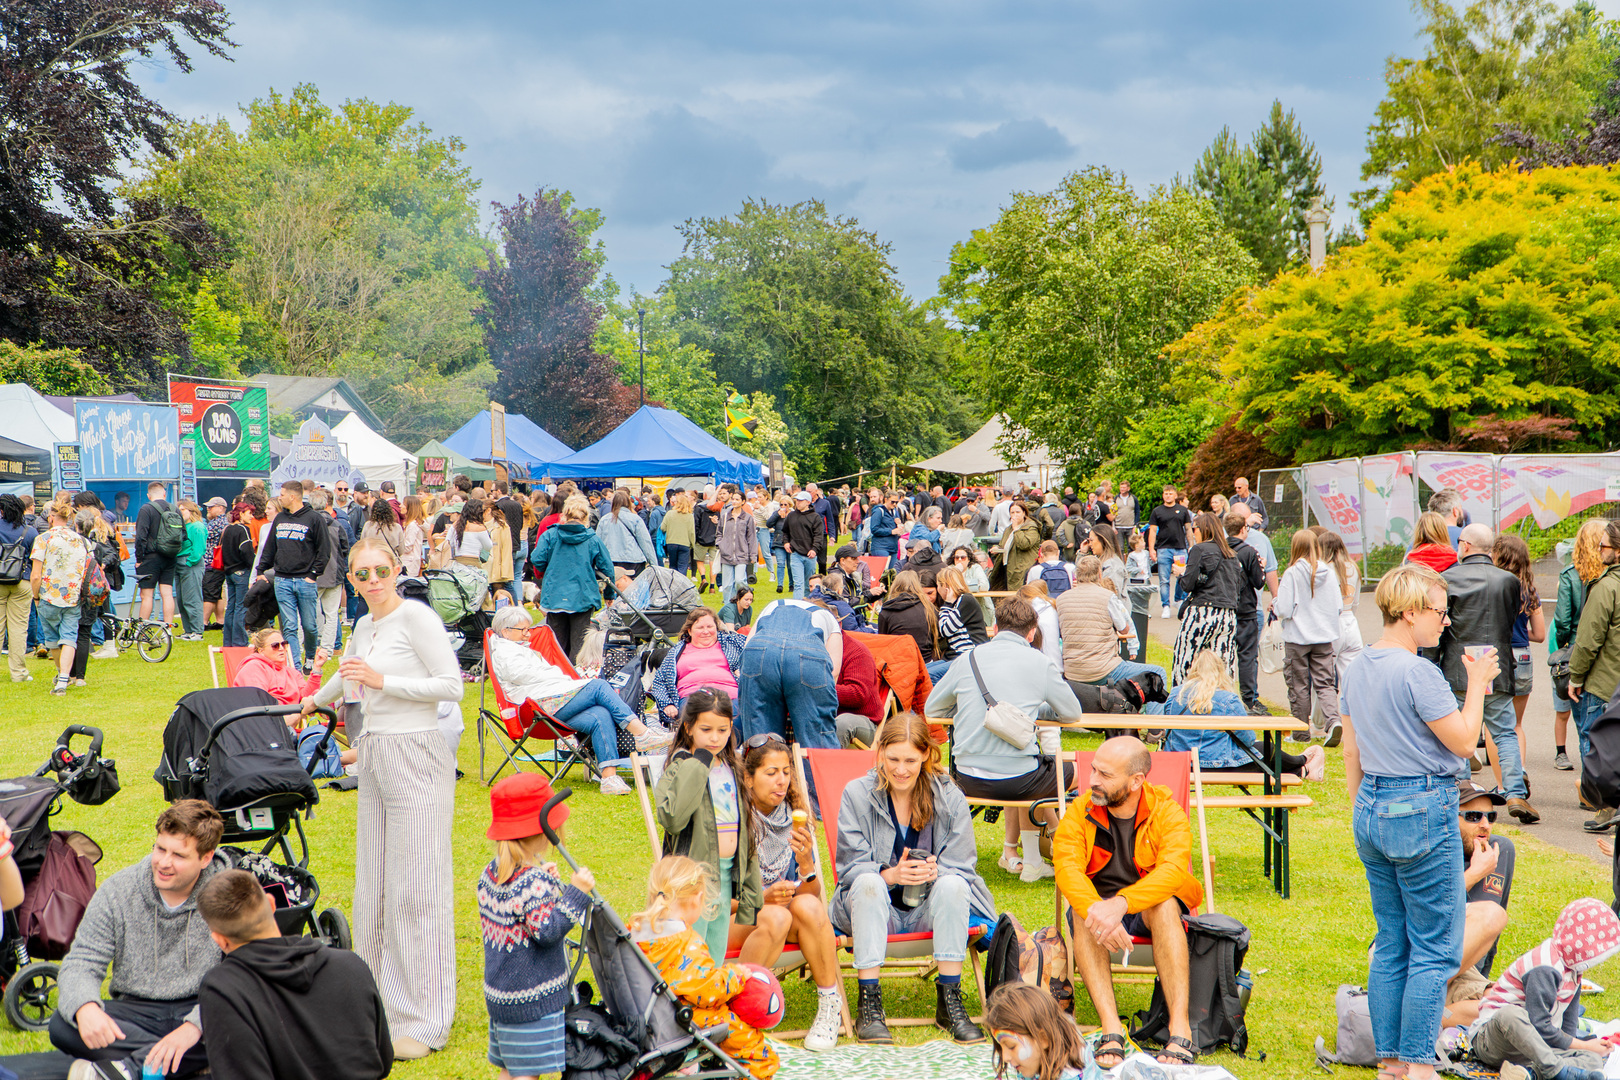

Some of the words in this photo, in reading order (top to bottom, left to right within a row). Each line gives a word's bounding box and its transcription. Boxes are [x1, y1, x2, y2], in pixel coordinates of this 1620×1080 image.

[105, 408, 132, 434] Cheese
[212, 412, 231, 428] BAO
[208, 428, 236, 444] BUNS
[9, 461, 22, 474] FOOD
[1436, 464, 1494, 488] STREET
